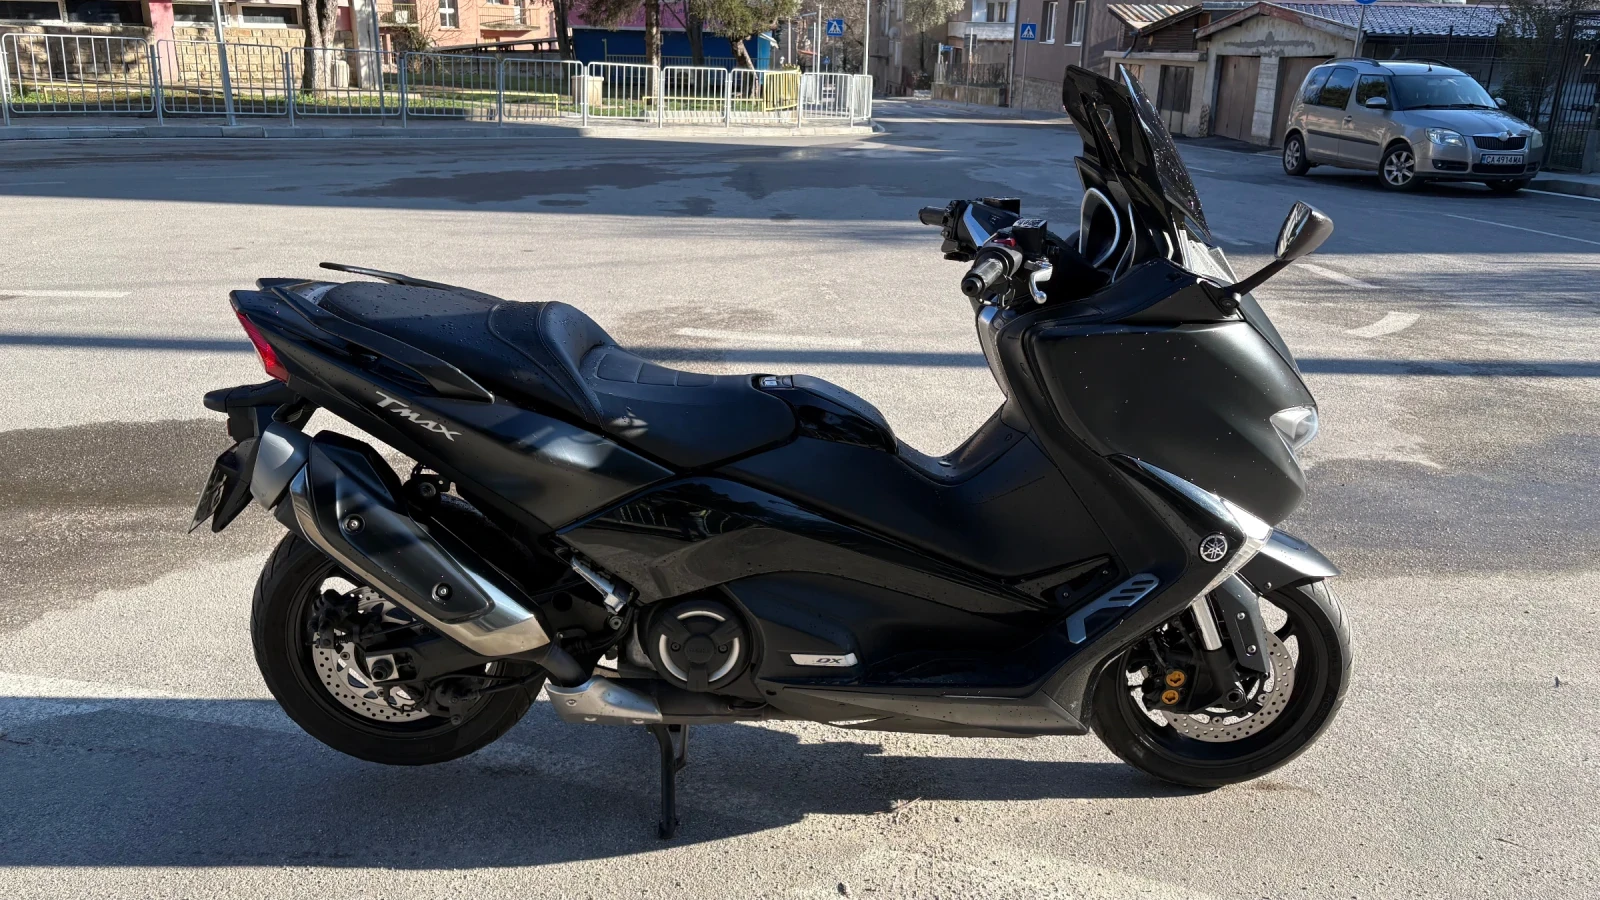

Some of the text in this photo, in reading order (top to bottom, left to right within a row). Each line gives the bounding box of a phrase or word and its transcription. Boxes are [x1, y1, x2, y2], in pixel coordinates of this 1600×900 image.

[1583, 53, 1591, 67] 7
[375, 390, 463, 442] TMAX
[1307, 692, 1334, 732] ROSSO
